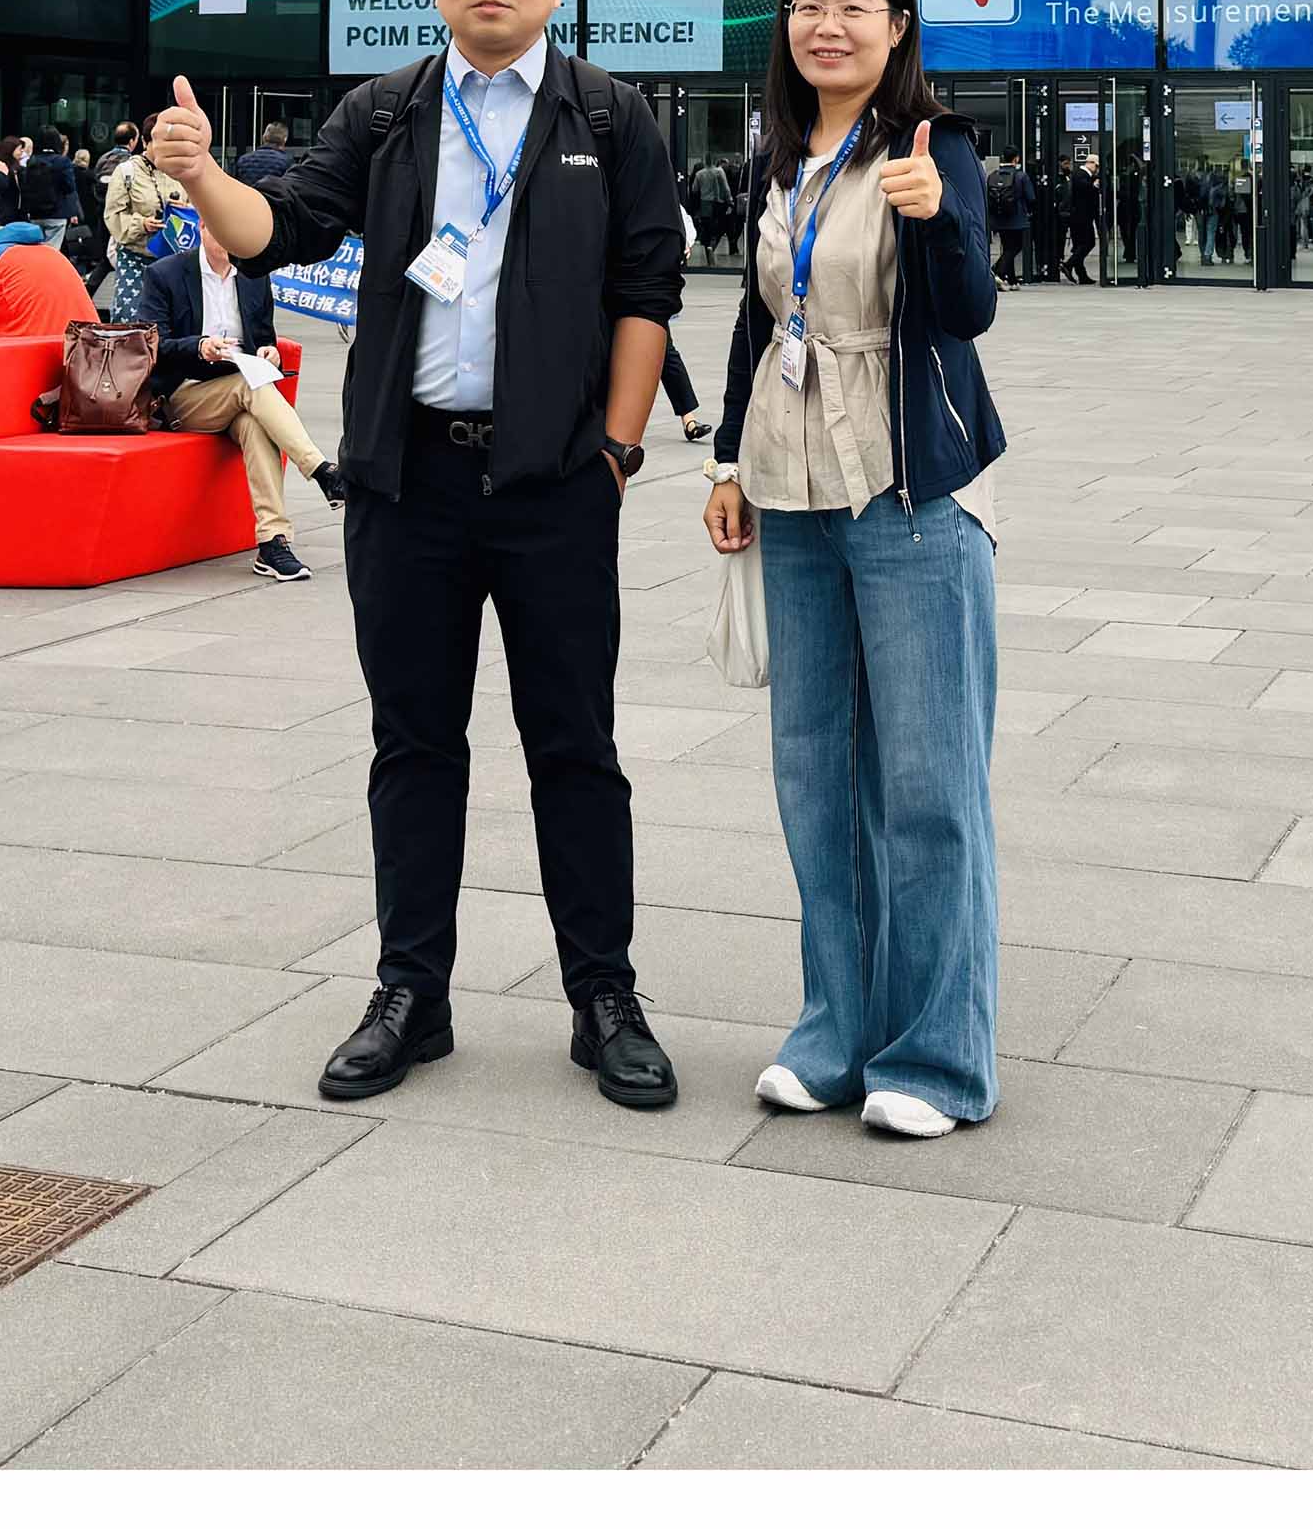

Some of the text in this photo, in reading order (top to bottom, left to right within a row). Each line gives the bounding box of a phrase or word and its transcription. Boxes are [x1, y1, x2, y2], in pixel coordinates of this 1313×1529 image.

[1045, 2, 1100, 25] The
[346, 21, 695, 47] PCIM EX NFERENCE!
